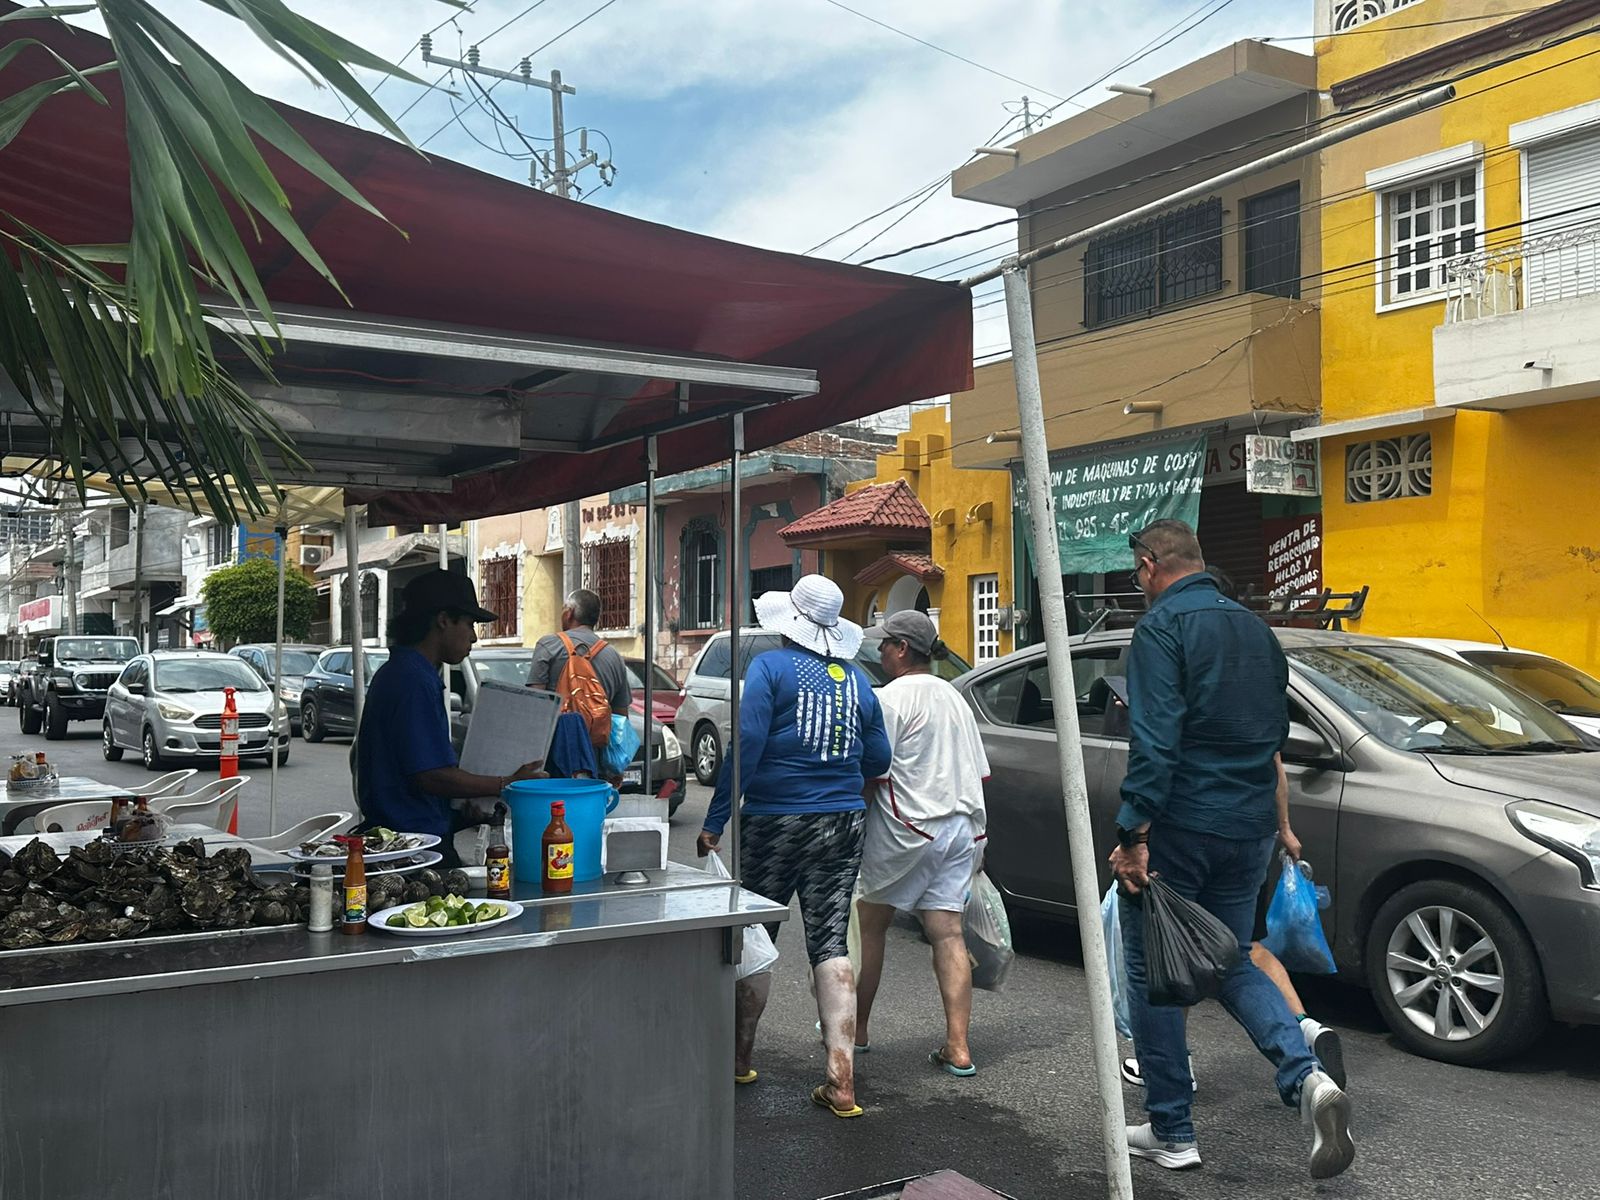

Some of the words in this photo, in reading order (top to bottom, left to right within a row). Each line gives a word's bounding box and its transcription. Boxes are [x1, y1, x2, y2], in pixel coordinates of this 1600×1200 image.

[1253, 438, 1315, 460] SINGER
[1065, 468, 1078, 485] DE
[1083, 459, 1138, 483] MAQUINAS
[1142, 455, 1159, 475] DE
[1119, 486, 1132, 502] DE
[1268, 529, 1300, 556] VENTA
[1303, 519, 1316, 537] DE
[1268, 535, 1320, 573] REFACCIONES
[1274, 559, 1301, 584] HILOS
[1304, 554, 1312, 569] Y
[835, 683, 843, 720] TENNIS
